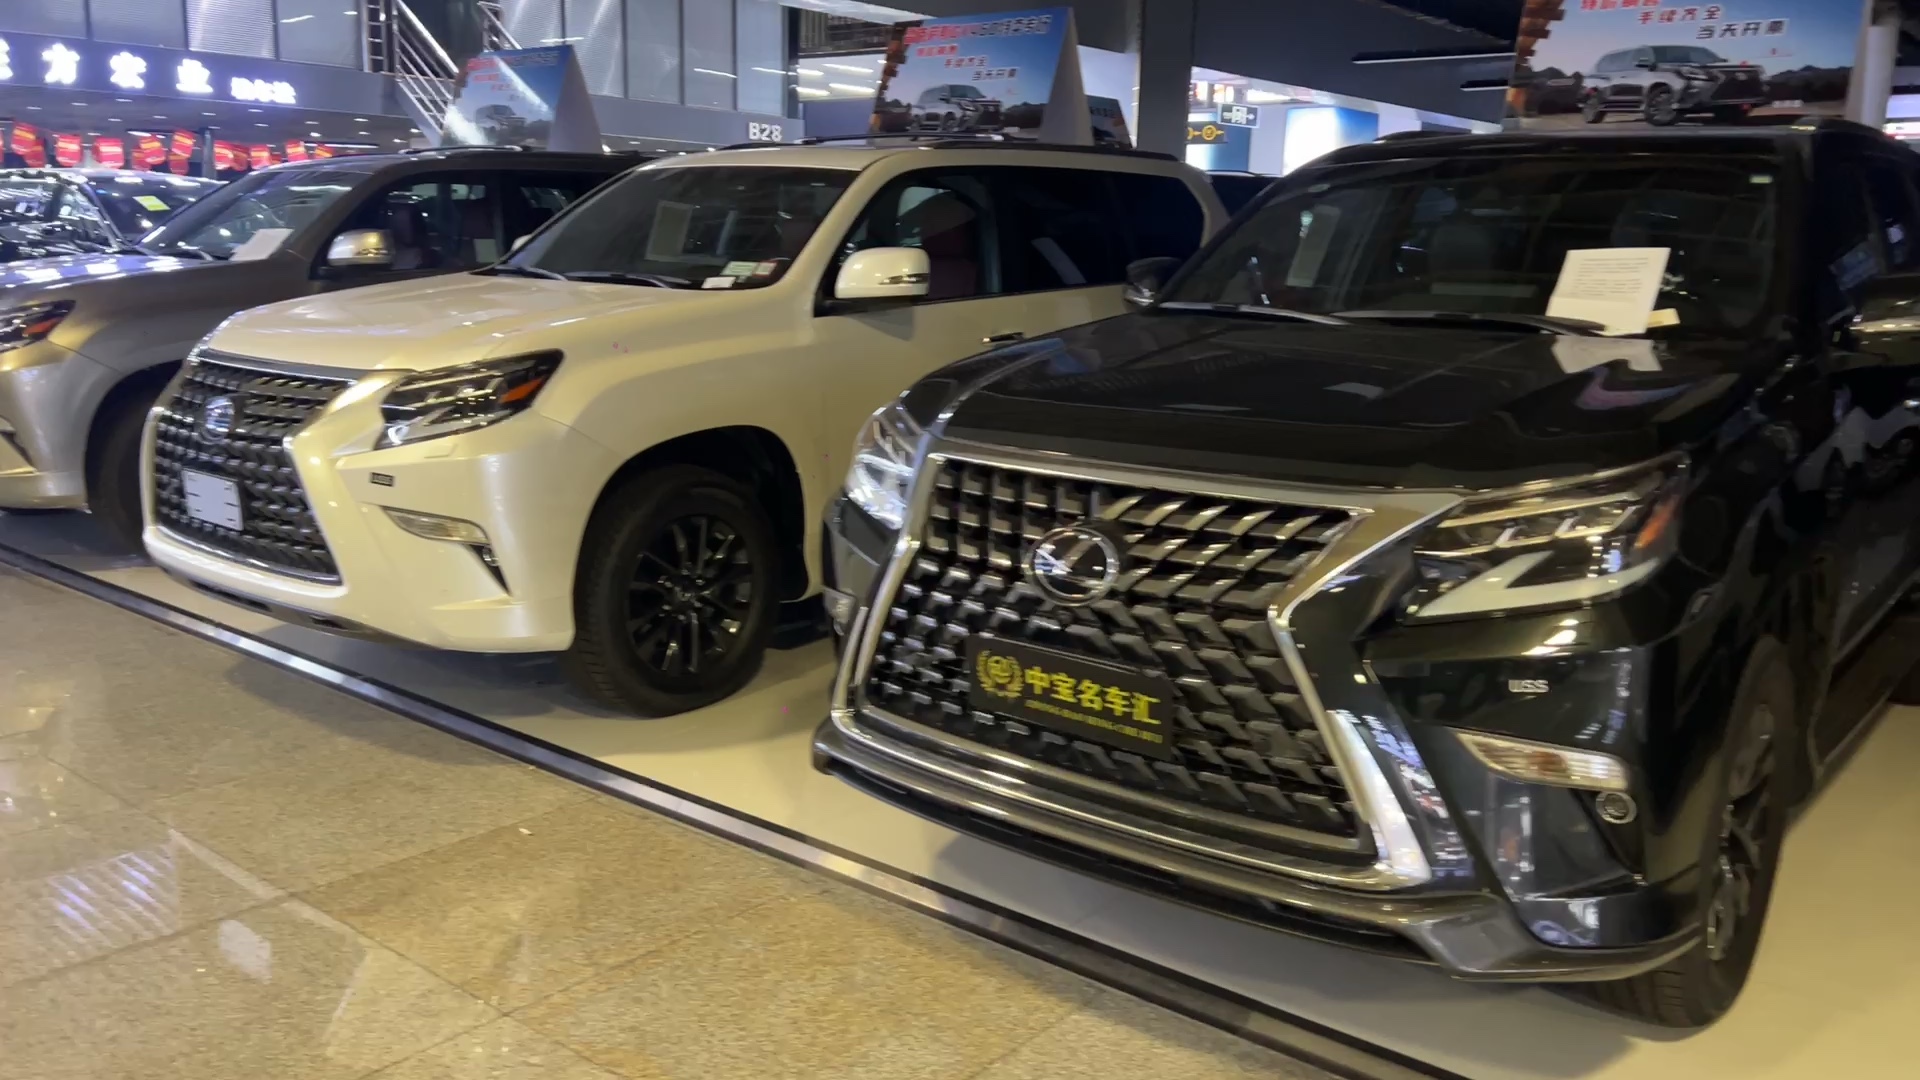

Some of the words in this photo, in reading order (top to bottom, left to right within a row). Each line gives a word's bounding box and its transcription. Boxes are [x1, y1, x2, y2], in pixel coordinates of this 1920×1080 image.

[1638, 5, 1722, 25] 手续齐全
[1696, 19, 1786, 40] 当天开票
[749, 122, 782, 141] B28
[1024, 666, 1162, 725] 中宝名车汇
